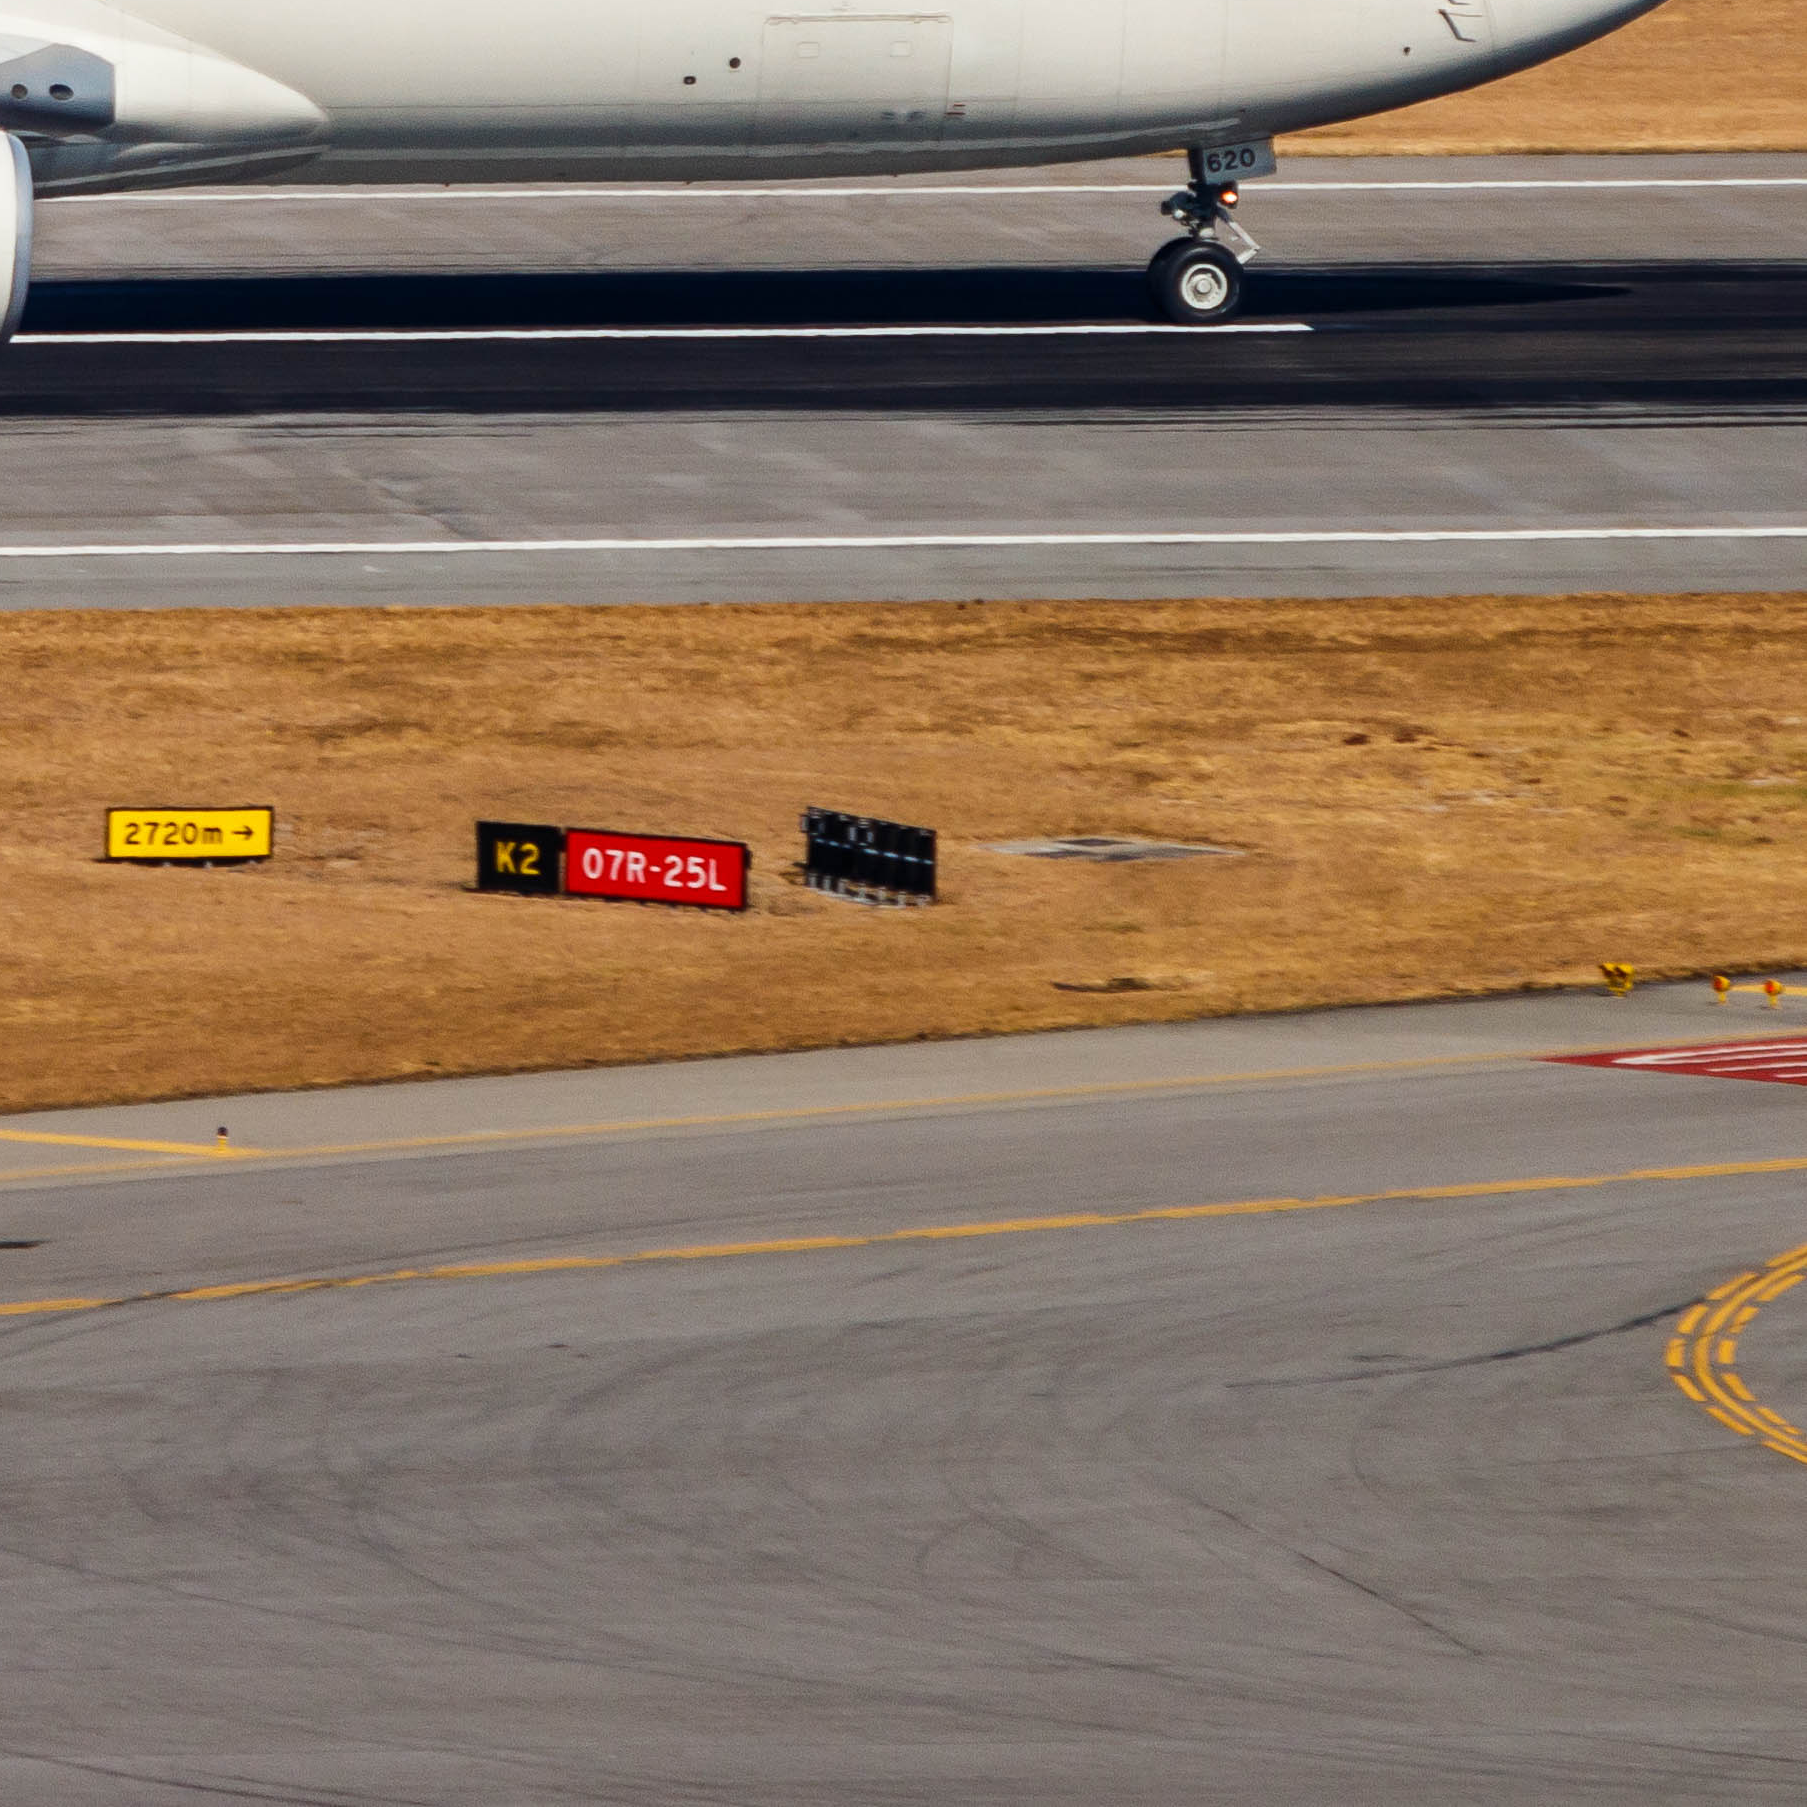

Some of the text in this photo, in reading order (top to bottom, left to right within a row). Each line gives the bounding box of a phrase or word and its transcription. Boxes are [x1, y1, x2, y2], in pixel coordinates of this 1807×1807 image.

[1207, 148, 1255, 172] 620
[124, 822, 223, 845] 2720m
[496, 841, 541, 875] K2
[582, 848, 728, 891] 07R-25L
